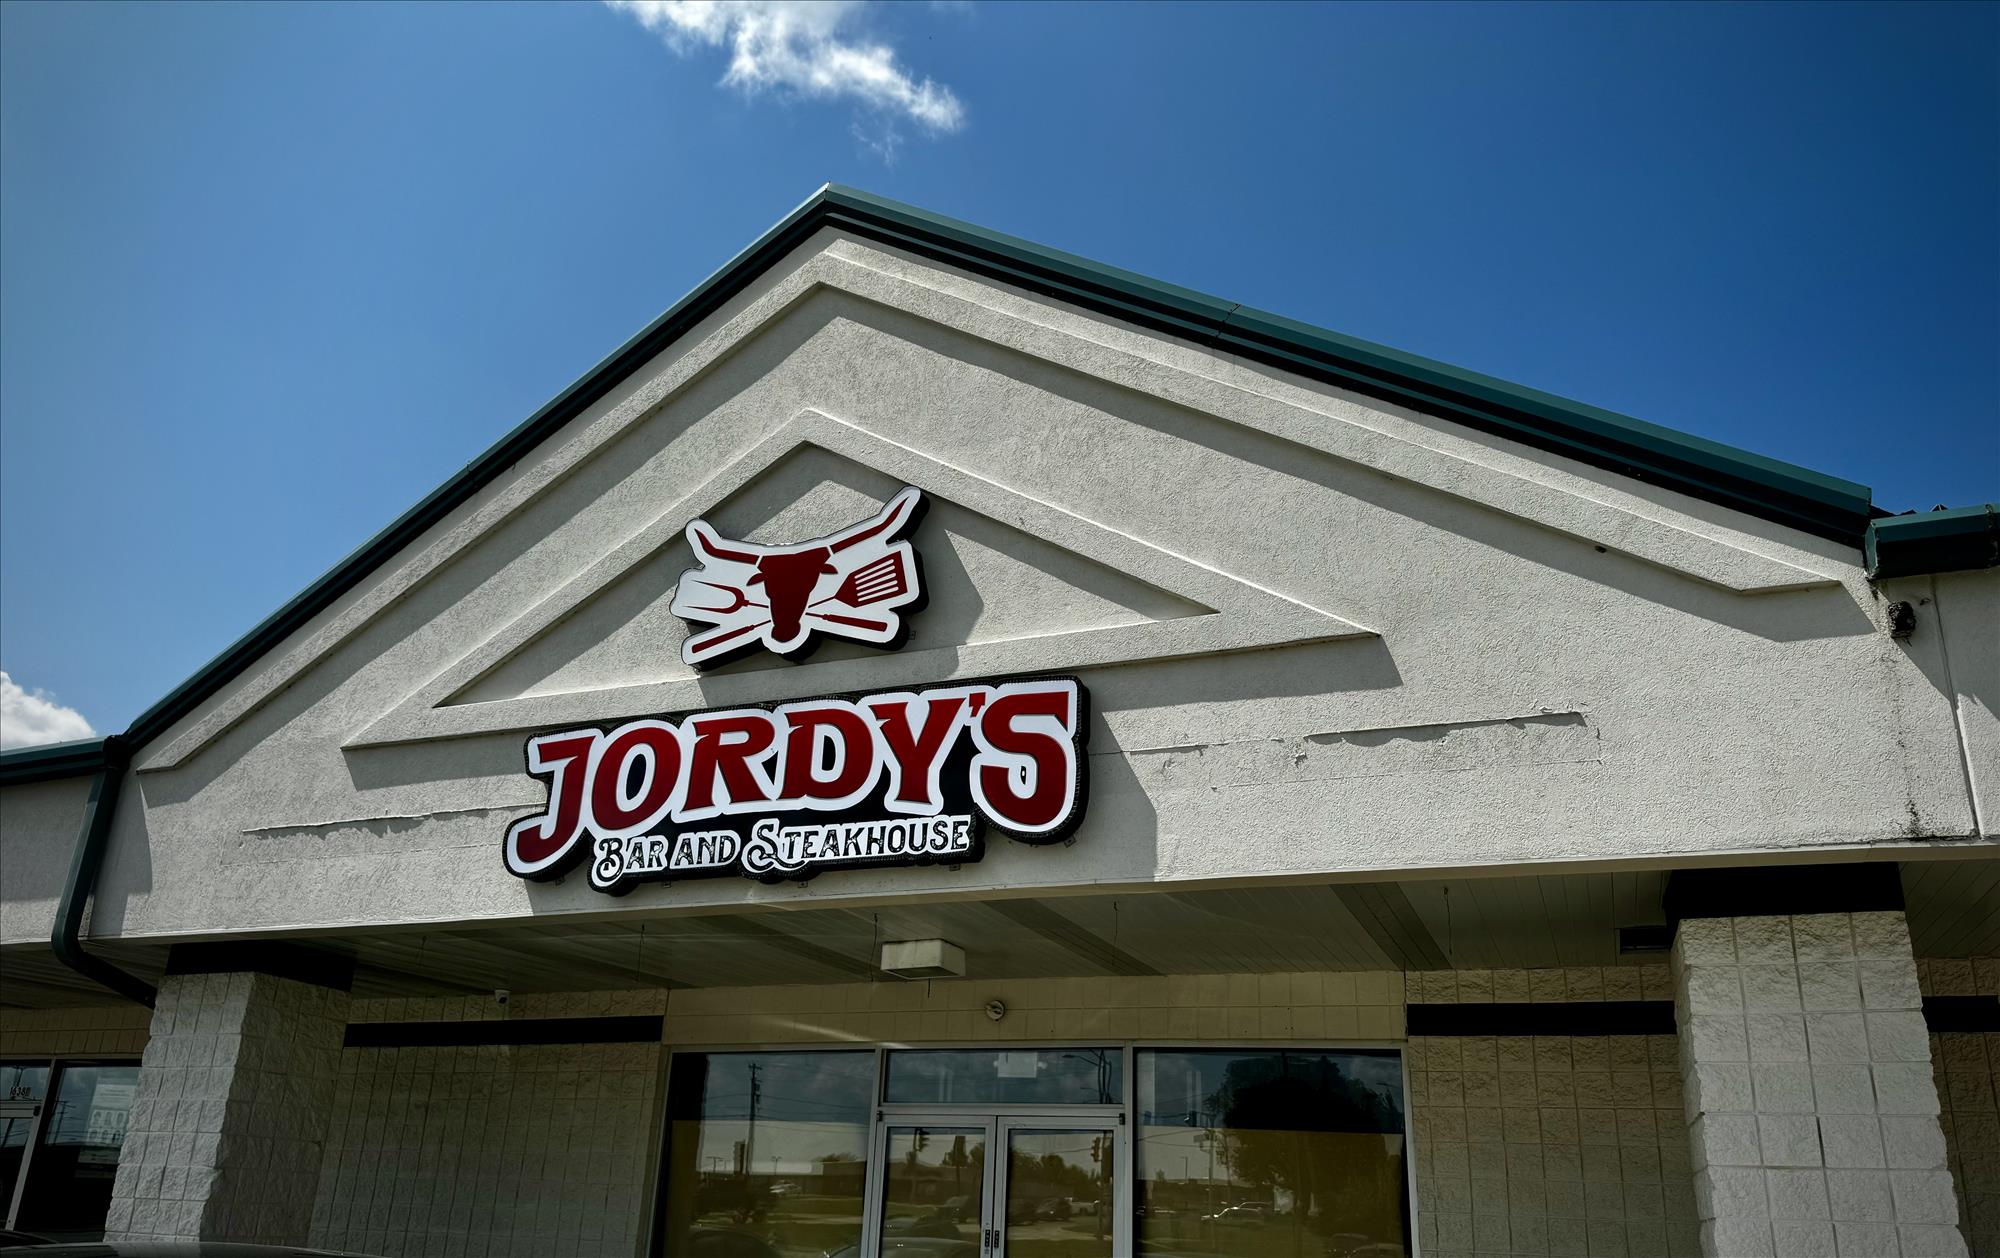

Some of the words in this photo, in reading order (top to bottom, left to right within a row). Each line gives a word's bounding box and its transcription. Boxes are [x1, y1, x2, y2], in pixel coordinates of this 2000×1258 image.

[514, 688, 1071, 866] JORDY'S
[595, 837, 667, 884] BAR
[673, 834, 740, 867] AND
[746, 820, 971, 872] STEAKHOUSE
